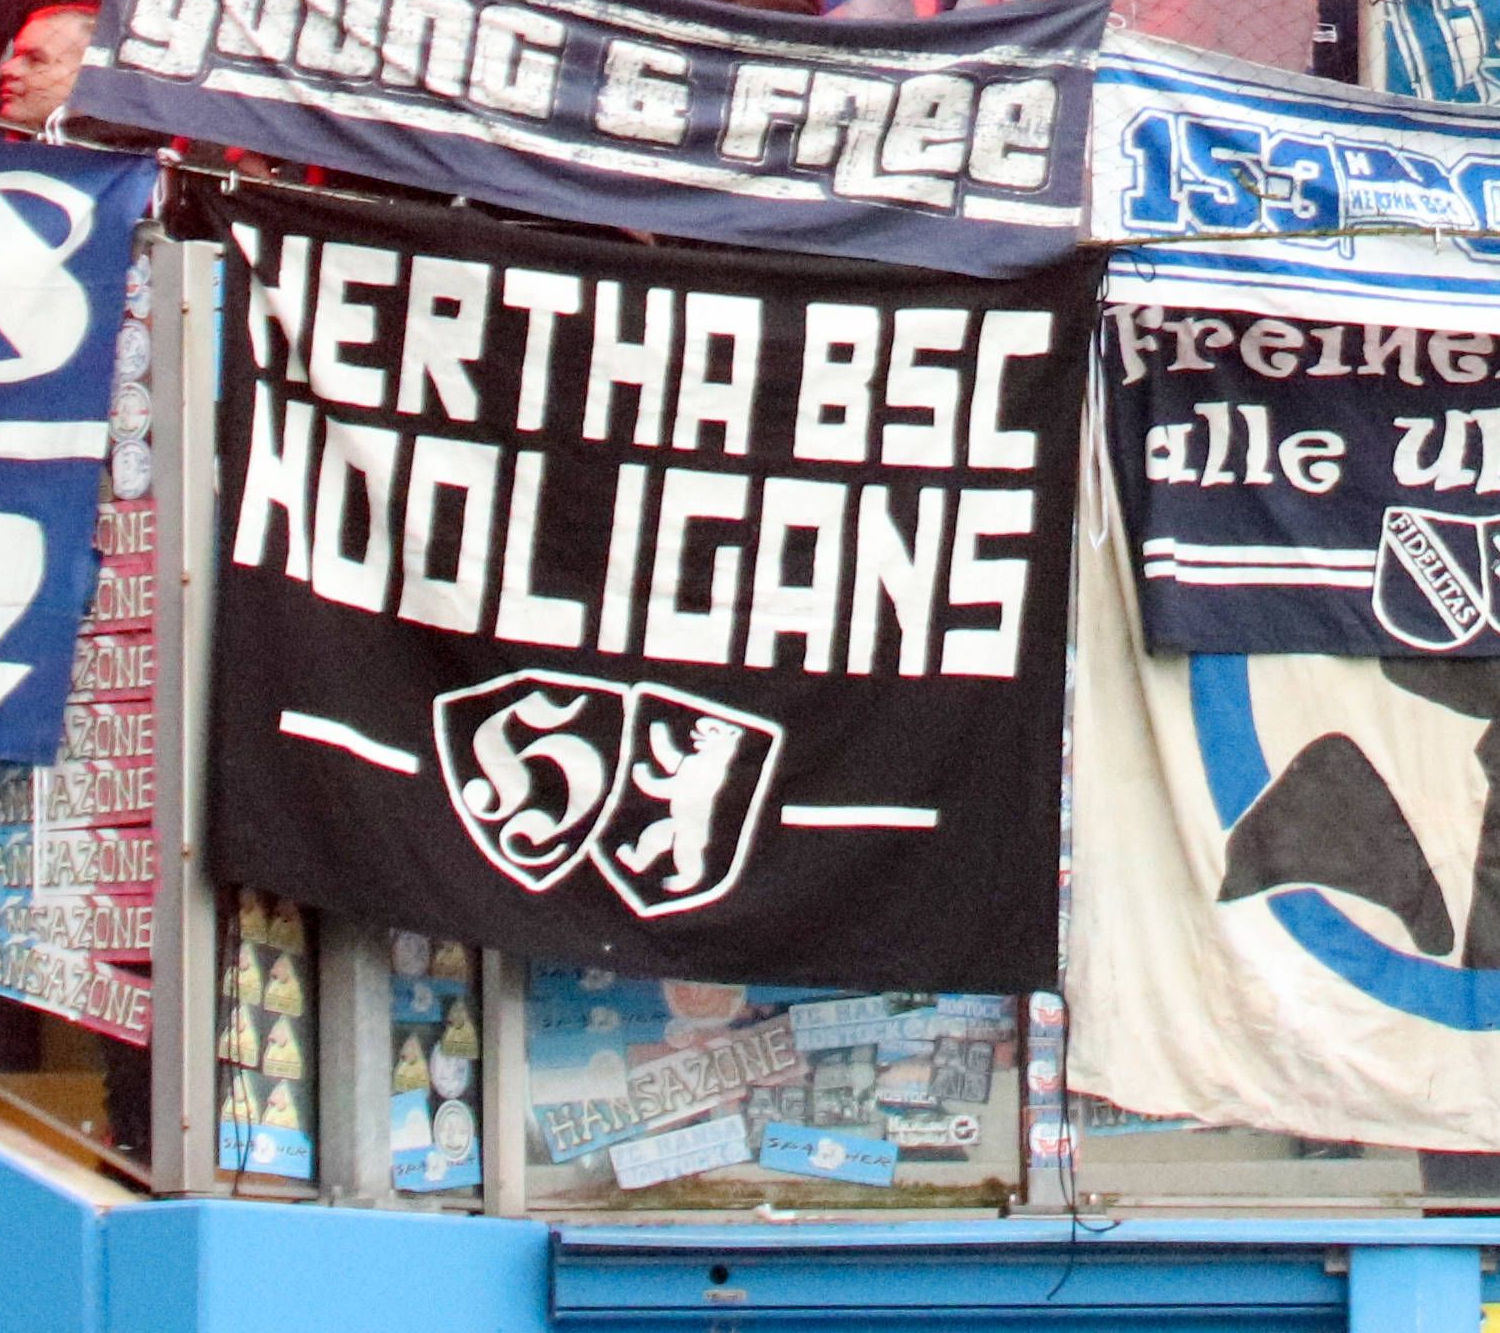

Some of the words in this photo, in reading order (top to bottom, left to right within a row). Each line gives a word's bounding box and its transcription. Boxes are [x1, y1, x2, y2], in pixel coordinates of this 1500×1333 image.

[596, 38, 692, 147] &
[1122, 108, 1346, 253] 153
[231, 222, 762, 455] HERTHA
[794, 303, 1053, 471] BSC
[1145, 401, 1348, 495] alle
[233, 379, 1035, 680] HOOLIGANS
[1387, 514, 1477, 626] FIDELITAS
[547, 1026, 797, 1151] HANSAZONE
